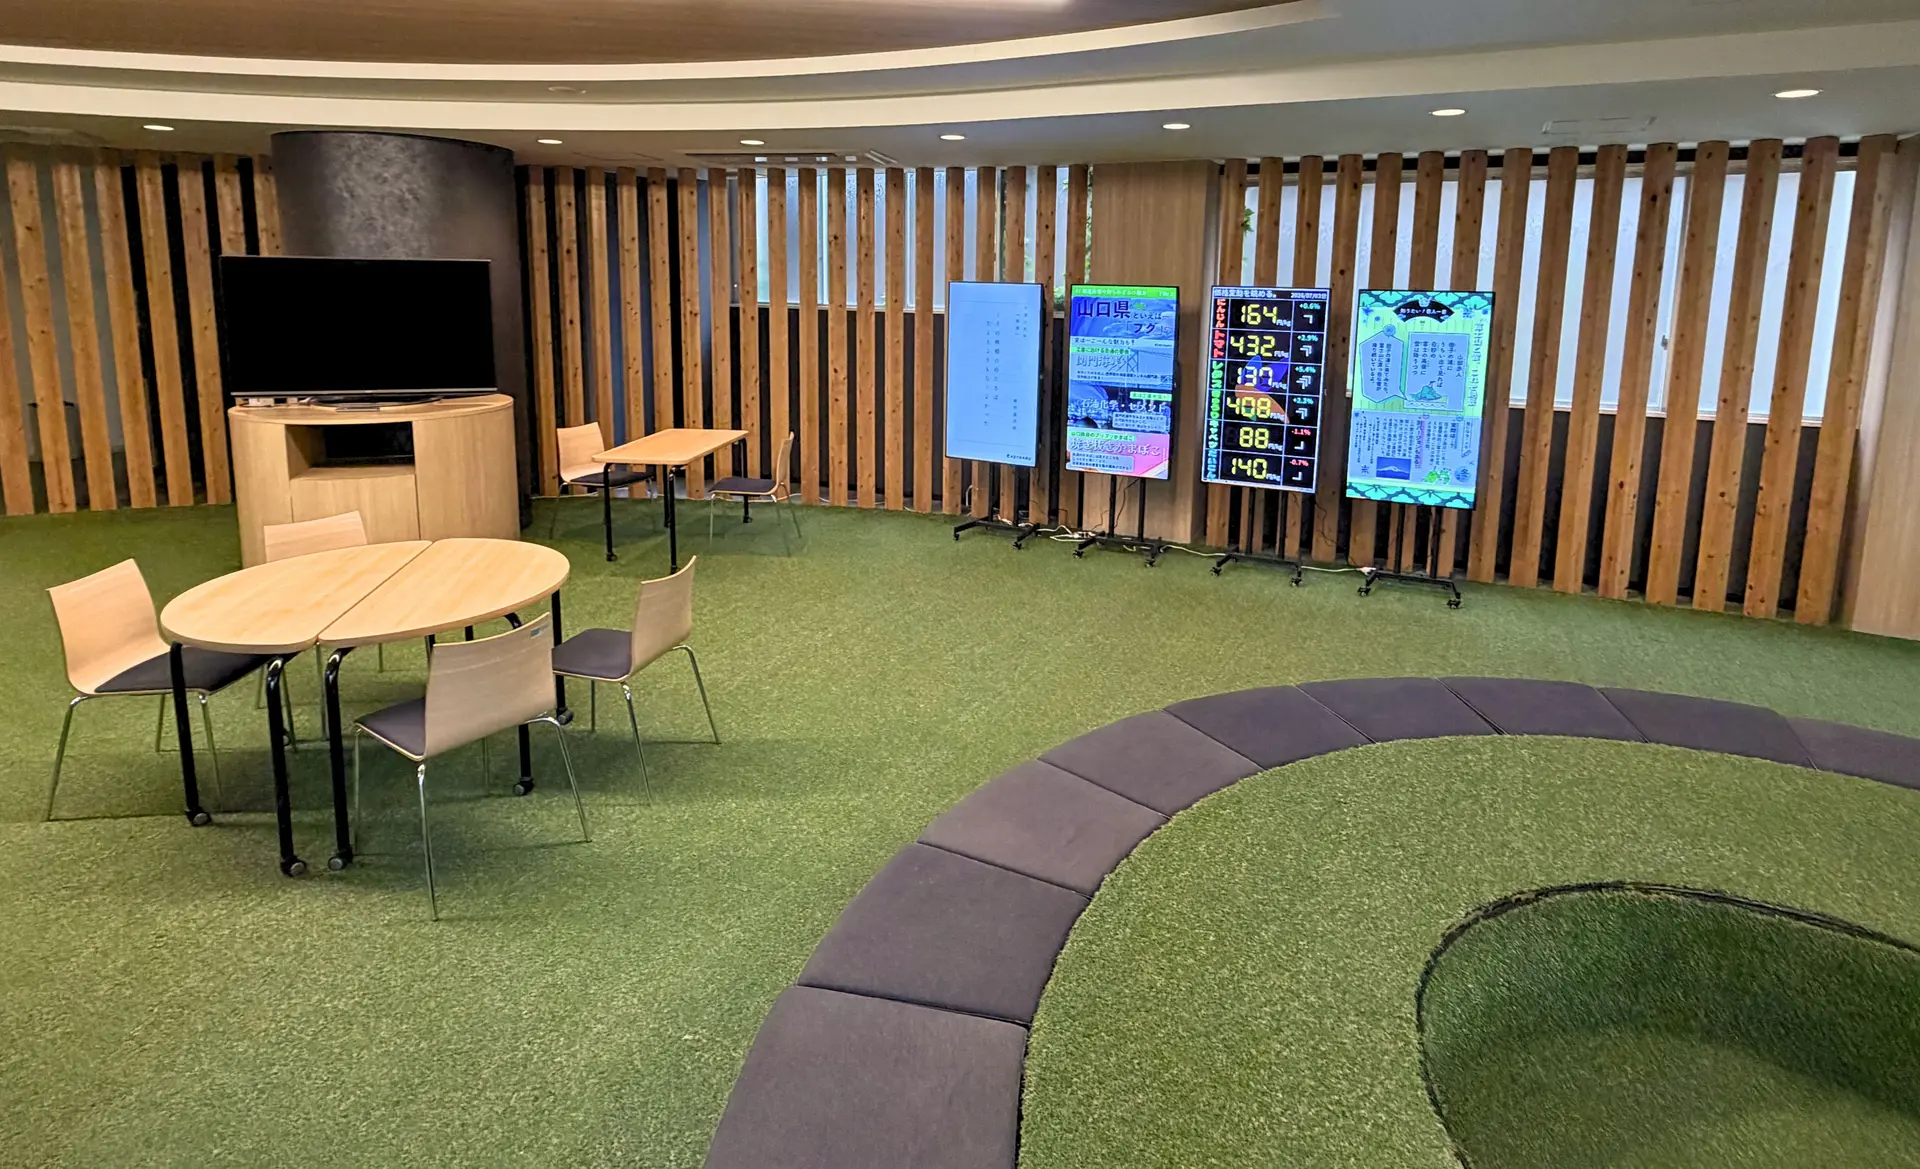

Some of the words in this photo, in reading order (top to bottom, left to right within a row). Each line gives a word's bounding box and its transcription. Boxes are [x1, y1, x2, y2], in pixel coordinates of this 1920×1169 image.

[1078, 300, 1131, 319] 山口県
[1216, 298, 1226, 328] にんじん
[1241, 304, 1278, 325] 164
[1213, 330, 1225, 358] トマト
[1230, 335, 1276, 357] 432
[1297, 334, 1319, 342] +2.9%
[1211, 361, 1224, 389] レタス
[1237, 366, 1273, 387] 137
[1227, 396, 1271, 419] 408
[1239, 427, 1269, 449] 88
[1291, 428, 1311, 436] -1.1%
[1070, 438, 1161, 456] 焼き抜きかまぼこ
[1231, 458, 1267, 479] 140
